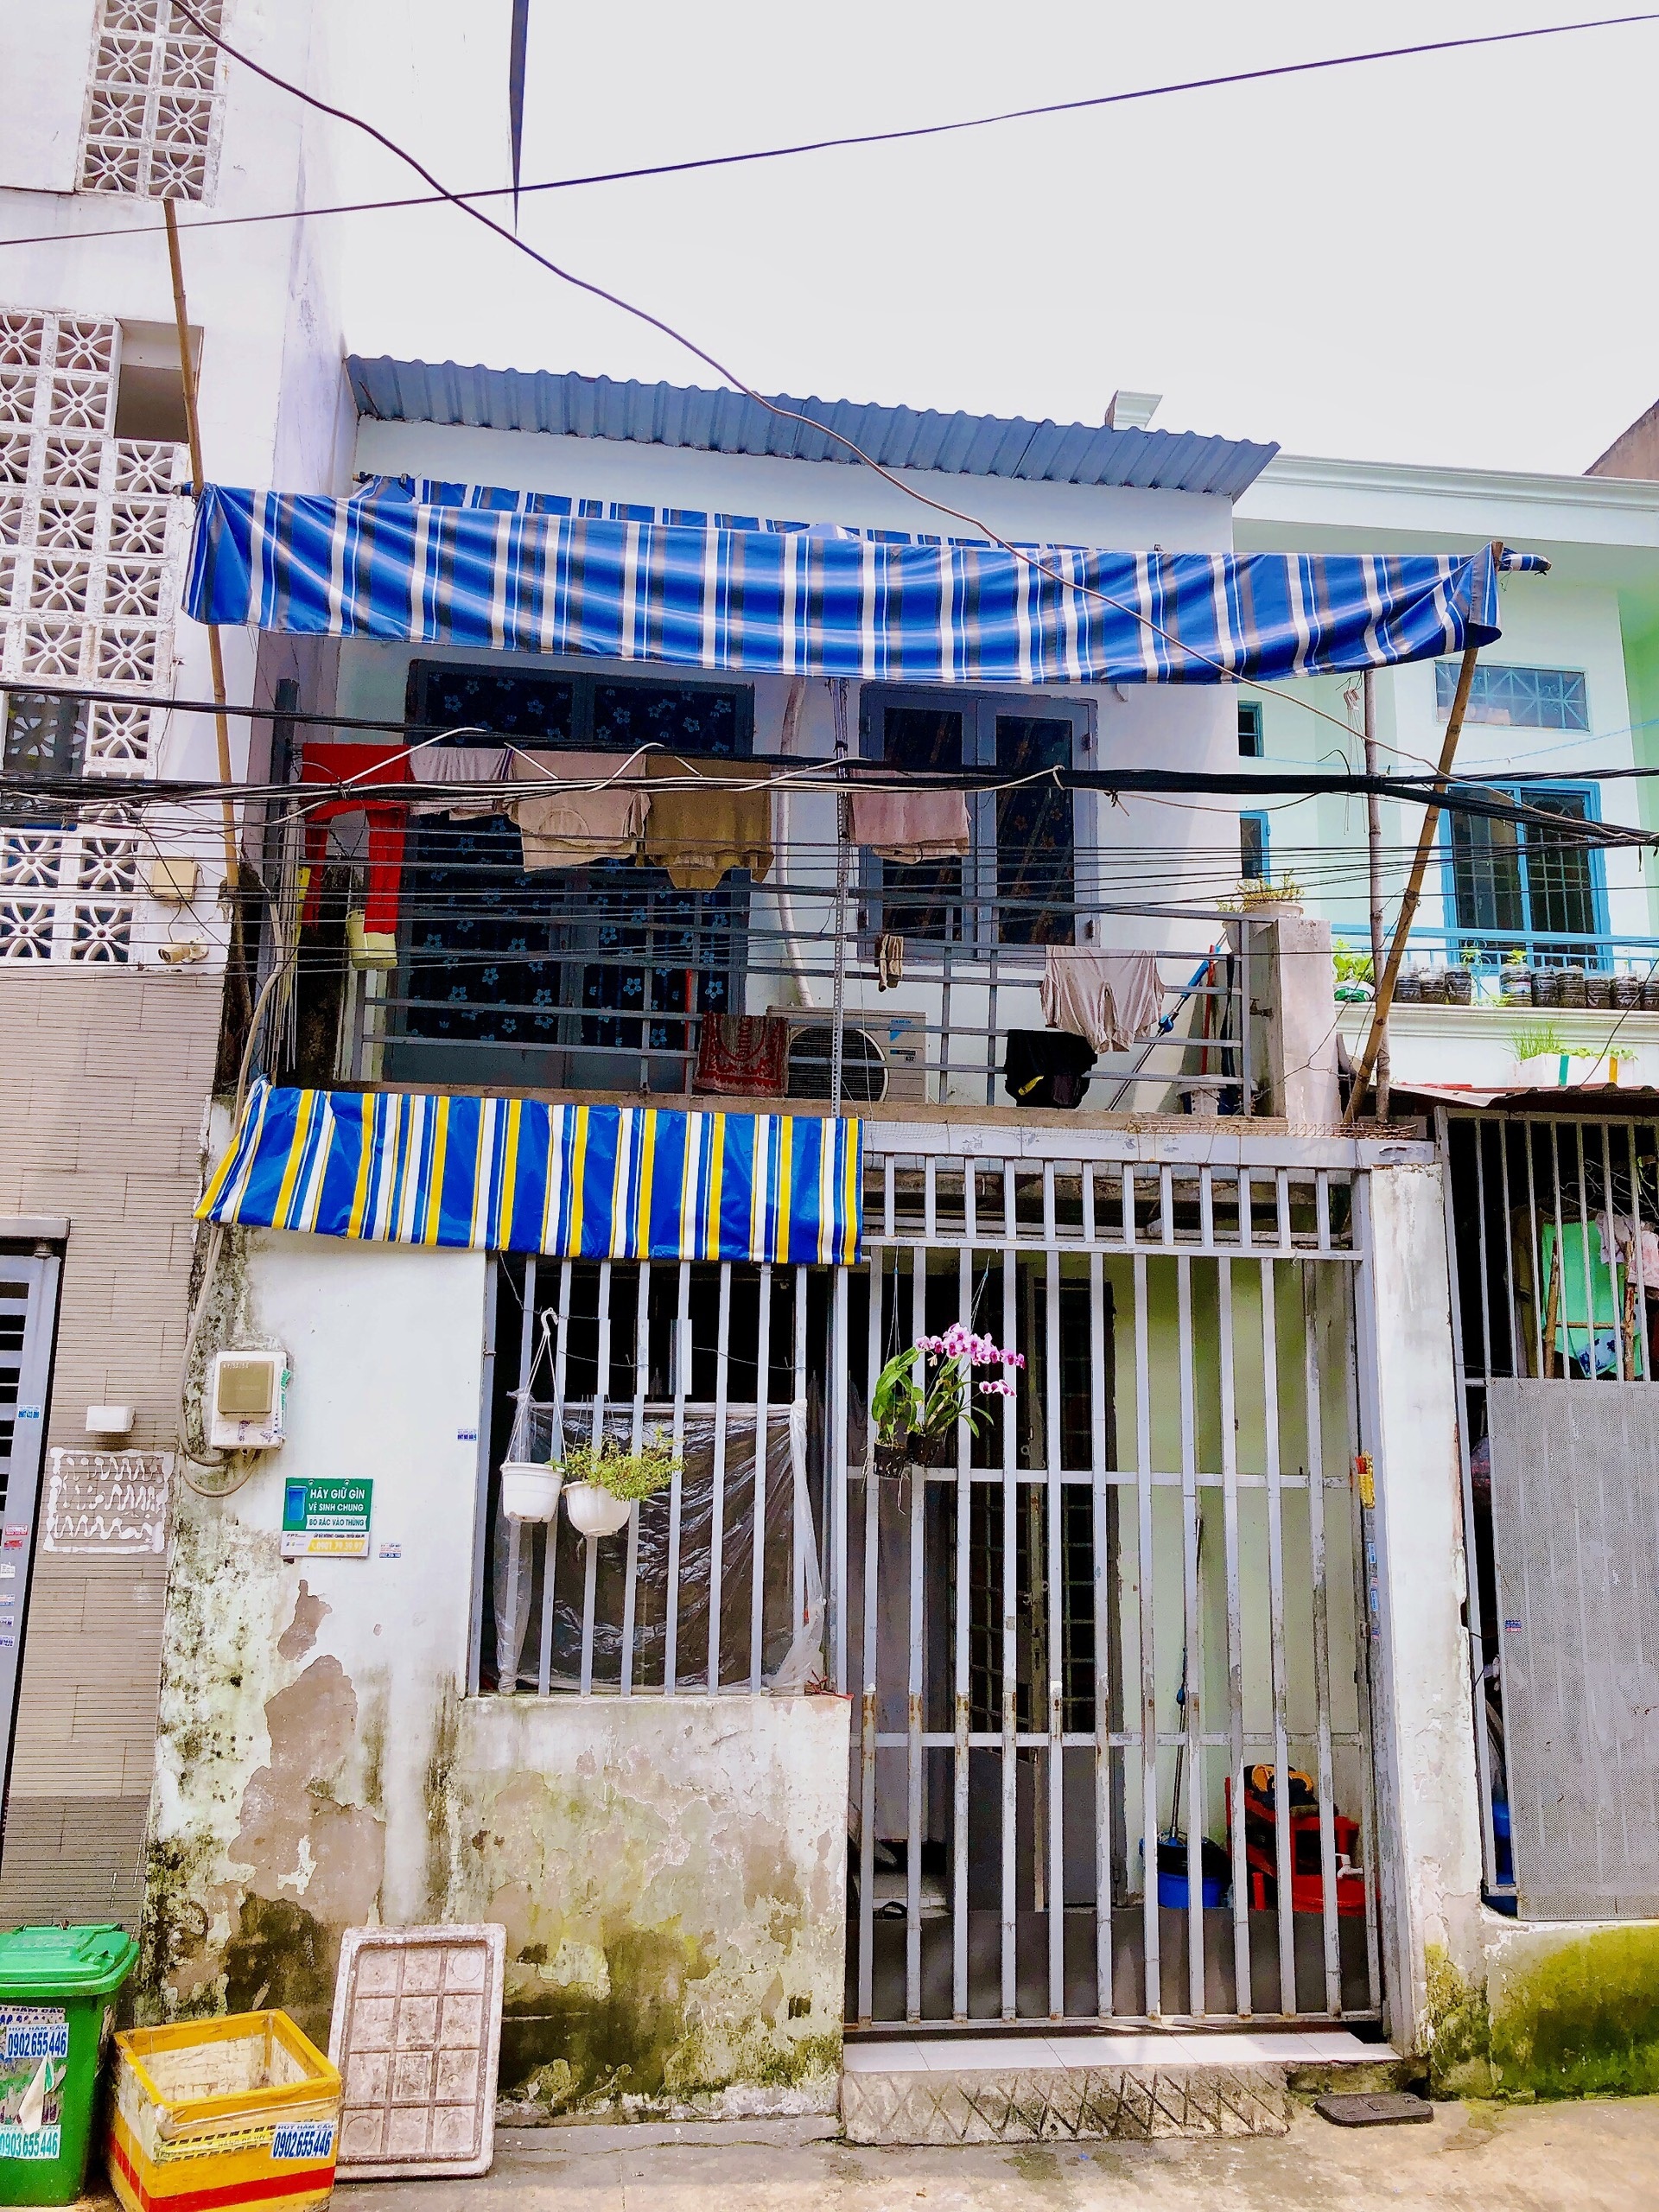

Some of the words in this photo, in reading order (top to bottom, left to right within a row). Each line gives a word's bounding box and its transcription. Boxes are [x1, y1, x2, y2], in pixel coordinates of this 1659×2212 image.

[309, 1486, 329, 1499] HÃY
[330, 1486, 347, 1499] GIỮ
[348, 1486, 365, 1499] GÌN
[308, 1501, 318, 1513] VỆ
[308, 1516, 318, 1526] BỎ
[318, 1516, 331, 1526] RÁC
[332, 1516, 345, 1526] VÀO
[346, 1516, 365, 1526] THÙNG
[272, 2130, 333, 2158] 0902.655.446
